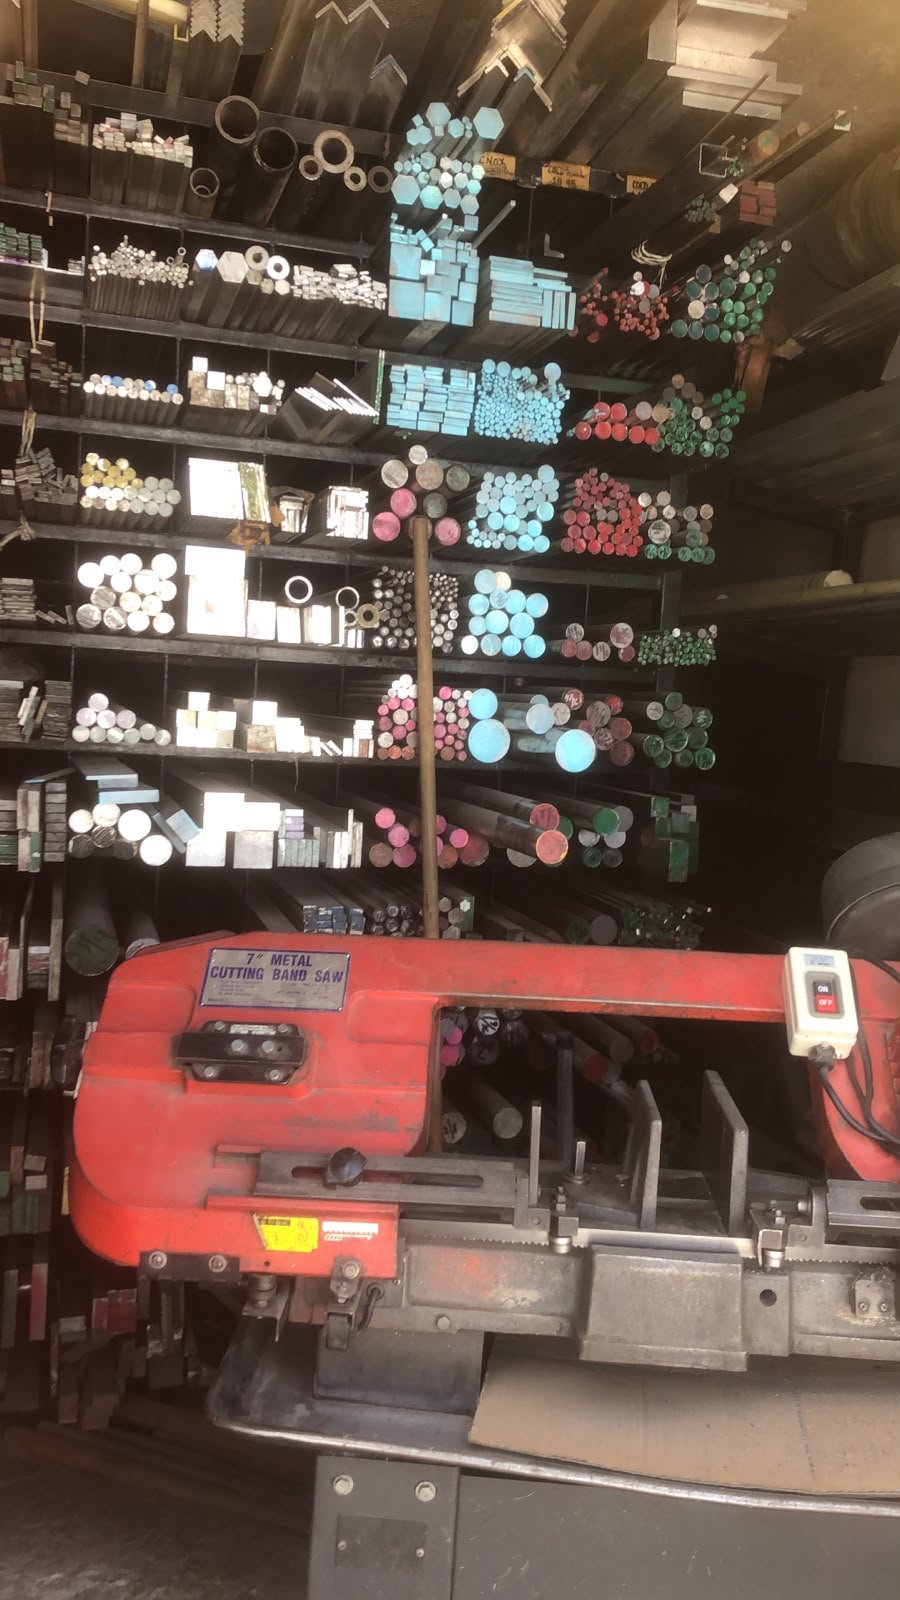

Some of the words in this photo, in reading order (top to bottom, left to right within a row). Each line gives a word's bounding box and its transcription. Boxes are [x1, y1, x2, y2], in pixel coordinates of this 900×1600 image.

[246, 953, 264, 965] 7"
[270, 954, 312, 967] METAL
[210, 966, 264, 980] CUTTING
[272, 968, 307, 982] BAND
[314, 970, 344, 983] SAW
[818, 985, 829, 993] ON
